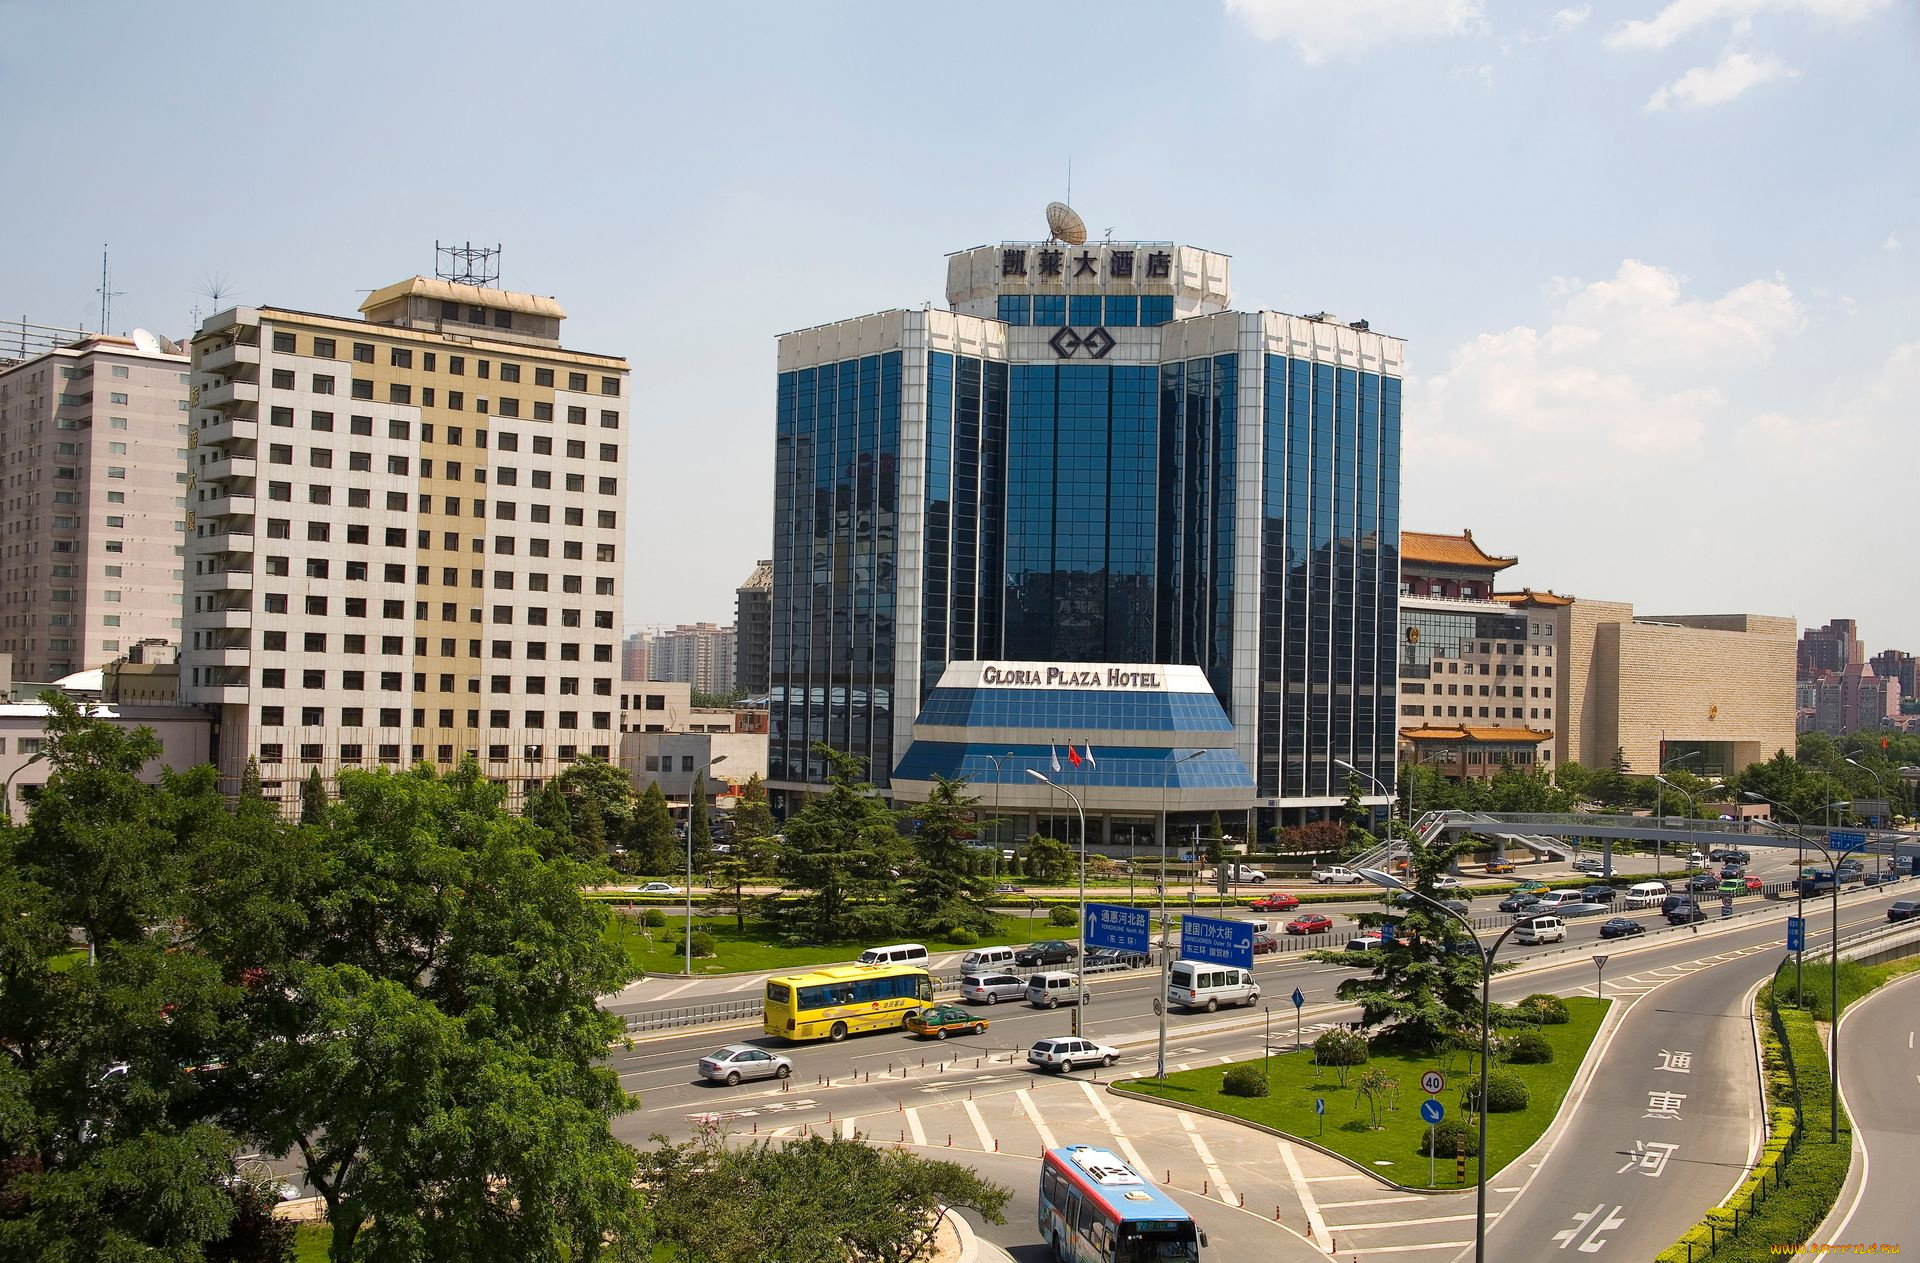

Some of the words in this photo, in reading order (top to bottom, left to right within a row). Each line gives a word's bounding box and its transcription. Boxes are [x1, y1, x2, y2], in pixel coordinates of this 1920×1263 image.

[1002, 249, 1172, 279] 凯莱大酒店
[983, 665, 1042, 686] GLORIA
[1046, 666, 1101, 687] PLAZA
[1107, 668, 1161, 688] HOTEL
[1101, 909, 1146, 927] 通惠河北路
[1184, 921, 1233, 941] 建国门外大街
[1425, 1077, 1440, 1089] 40
